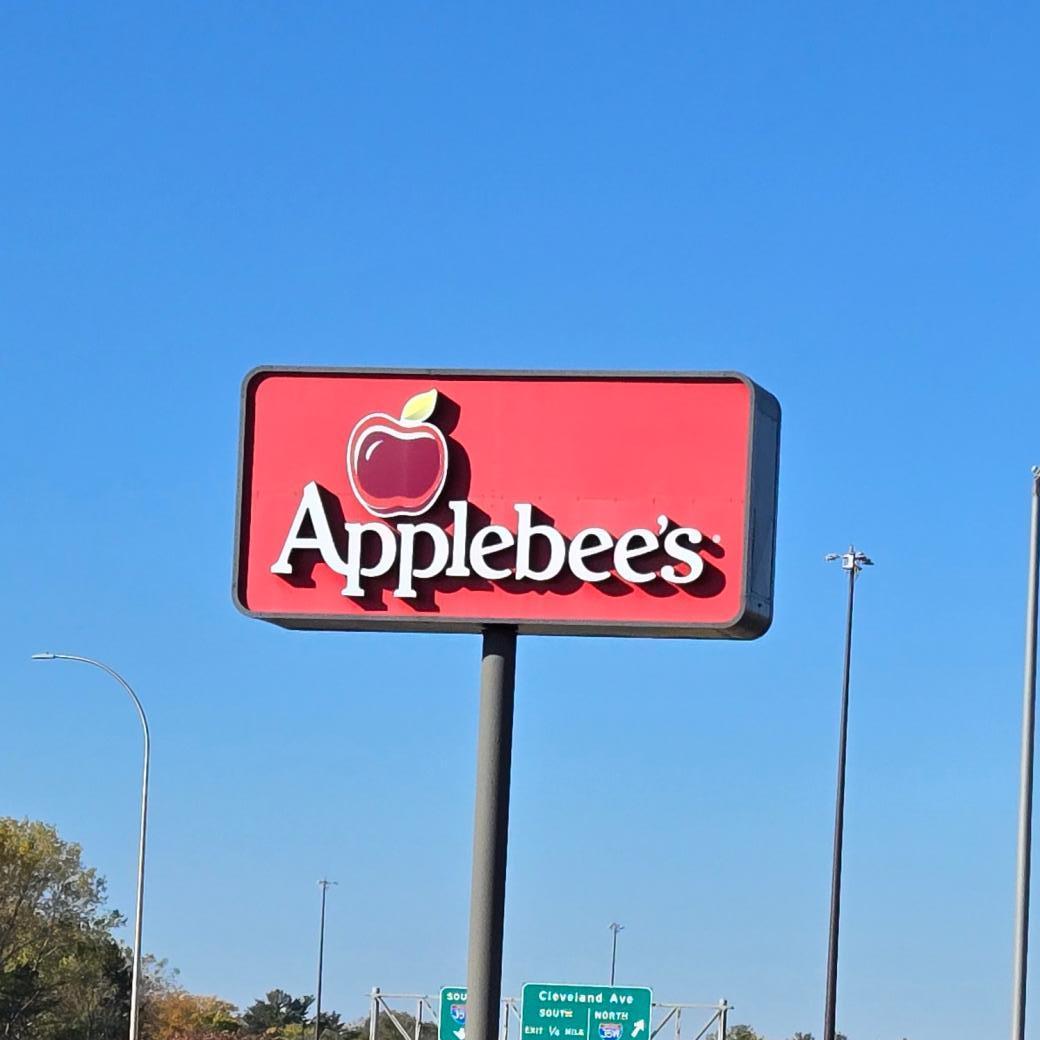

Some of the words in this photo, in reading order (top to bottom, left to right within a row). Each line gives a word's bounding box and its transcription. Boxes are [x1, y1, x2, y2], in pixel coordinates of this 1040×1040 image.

[270, 481, 704, 599] Applebee's
[446, 992, 468, 1001] SOU
[538, 990, 604, 1004] Cleveland
[609, 993, 635, 1005] Ave
[538, 1008, 574, 1018] SOUTH
[594, 1010, 630, 1021] NORTH
[524, 1025, 544, 1035] EXIT
[564, 1027, 585, 1037] MILE
